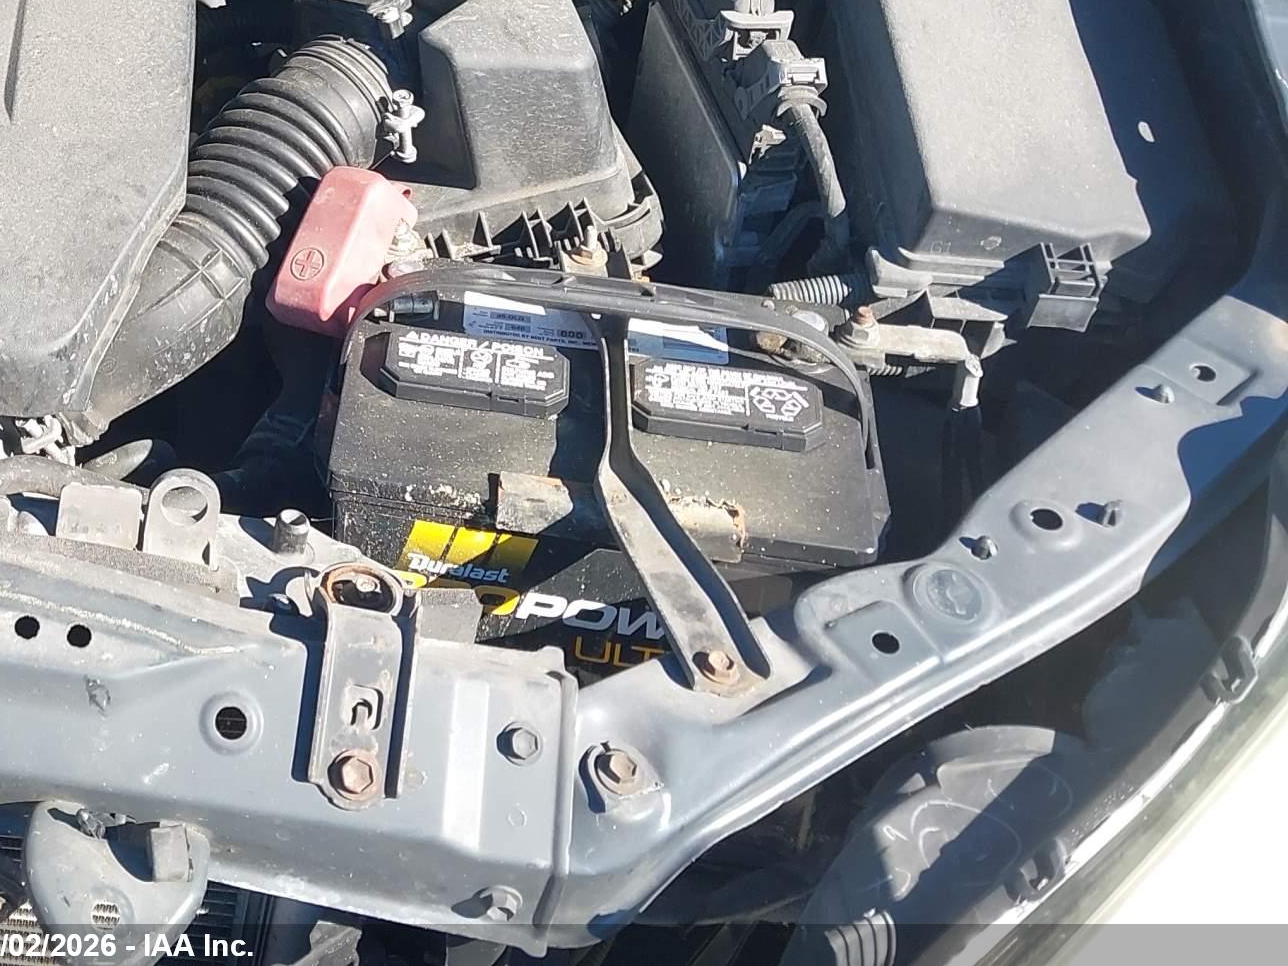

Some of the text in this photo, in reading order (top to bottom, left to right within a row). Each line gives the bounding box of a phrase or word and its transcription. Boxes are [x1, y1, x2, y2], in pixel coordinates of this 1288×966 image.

[420, 335, 477, 349] DANGER
[492, 341, 544, 357] POISON
[407, 552, 511, 583] Duralast
[574, 636, 665, 667] ULT
